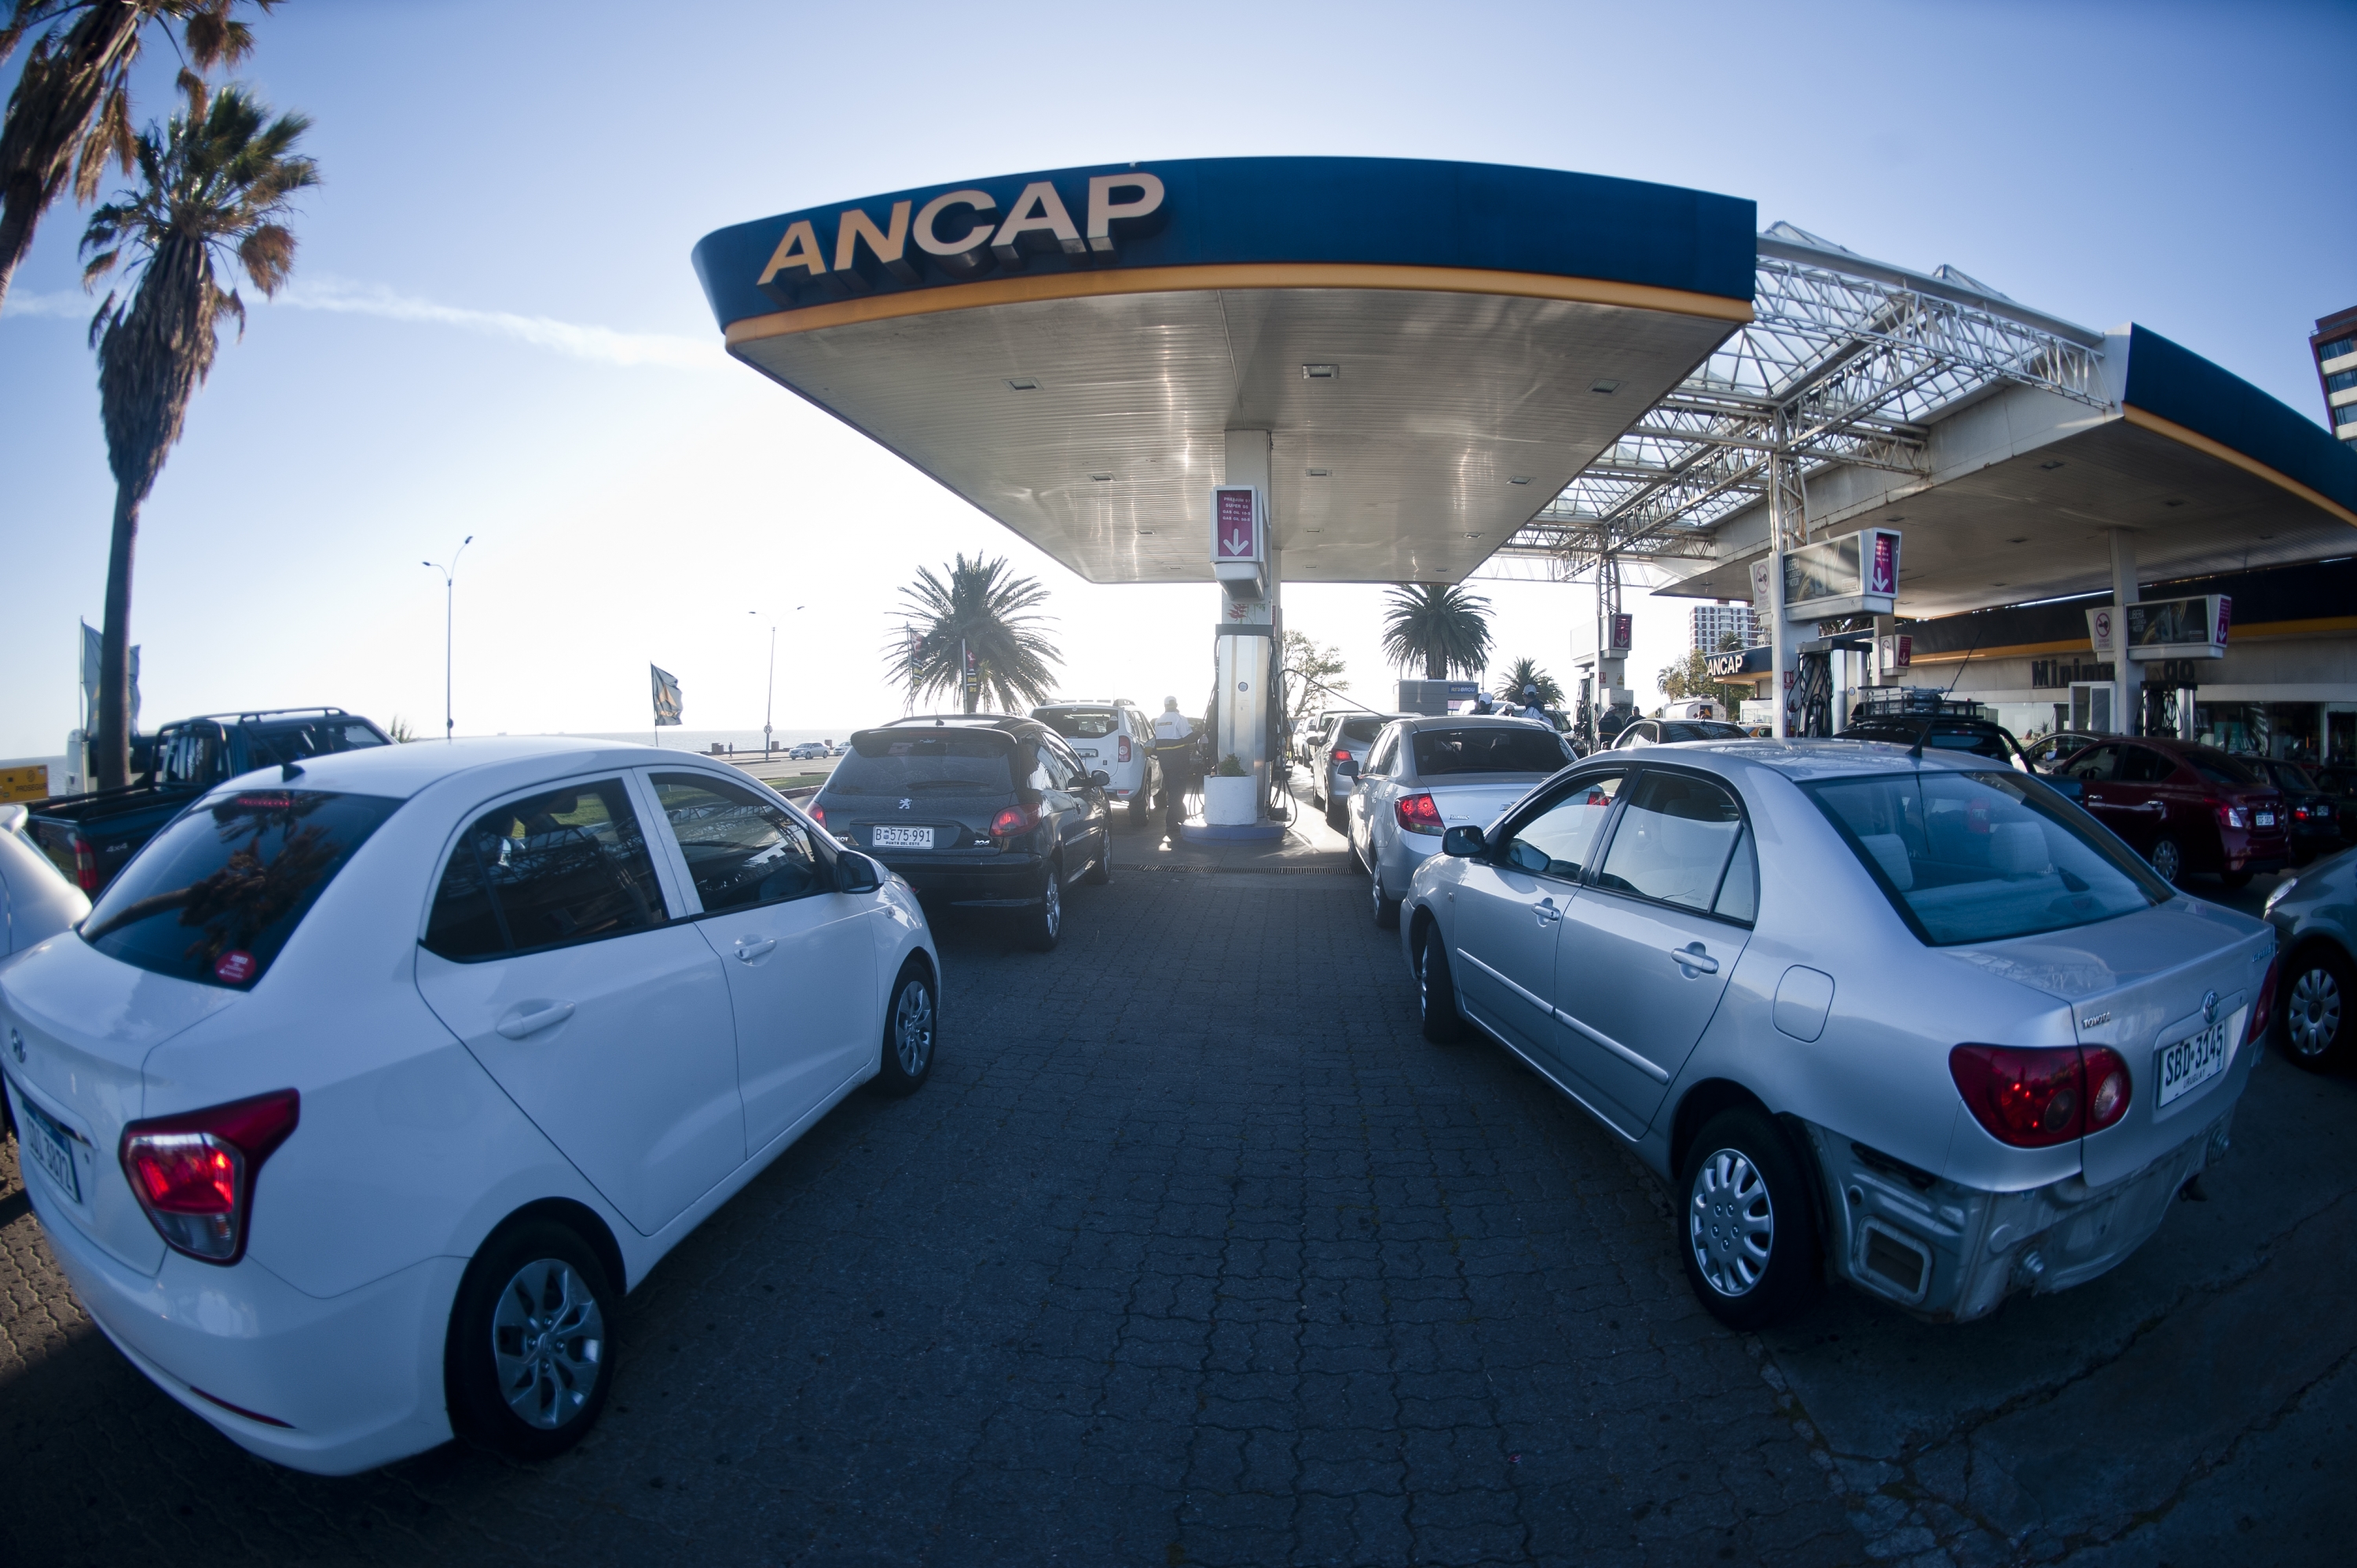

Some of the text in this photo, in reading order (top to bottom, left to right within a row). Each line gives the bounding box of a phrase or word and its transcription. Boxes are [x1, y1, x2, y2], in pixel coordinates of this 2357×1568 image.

[756, 172, 1165, 287] ANCAP
[1785, 556, 1800, 573] LIBERA
[2128, 609, 2144, 620] LIBERA
[1706, 654, 1743, 676] ANCAP
[16, 782, 47, 792] PROSEGUR
[875, 828, 882, 841] B
[105, 842, 129, 852] 4x4
[2083, 1011, 2111, 1028] TOYOTA
[2183, 1068, 2206, 1089] URUGUAY
